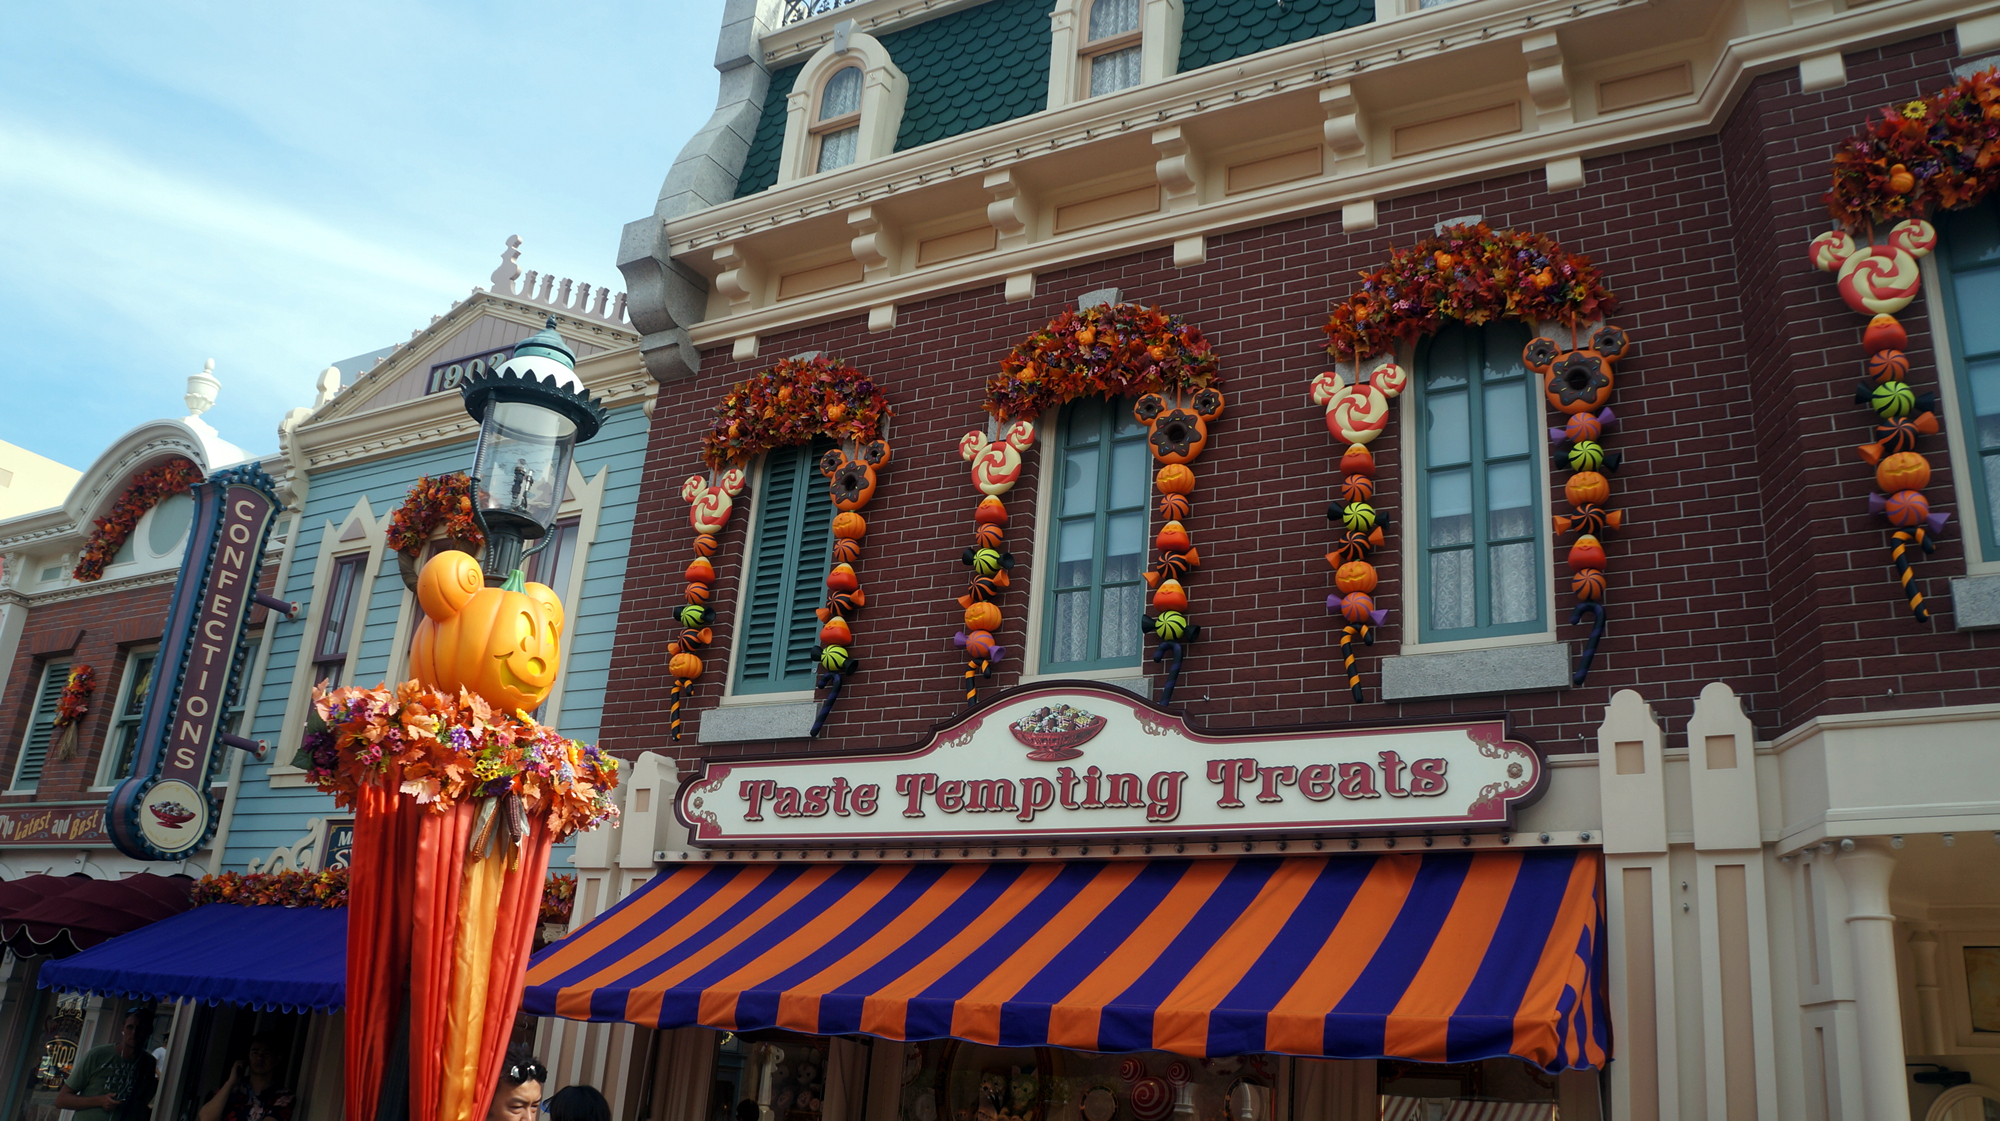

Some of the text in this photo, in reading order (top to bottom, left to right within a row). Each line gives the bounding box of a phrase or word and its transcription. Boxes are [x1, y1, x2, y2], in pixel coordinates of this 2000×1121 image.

[174, 499, 256, 770] CONFECTIONS
[739, 750, 1449, 823] Taste Tempting Treats
[13, 810, 52, 840] Latest
[51, 813, 72, 838] and
[69, 809, 99, 840] Best
[44, 1043, 76, 1067] SHOP
